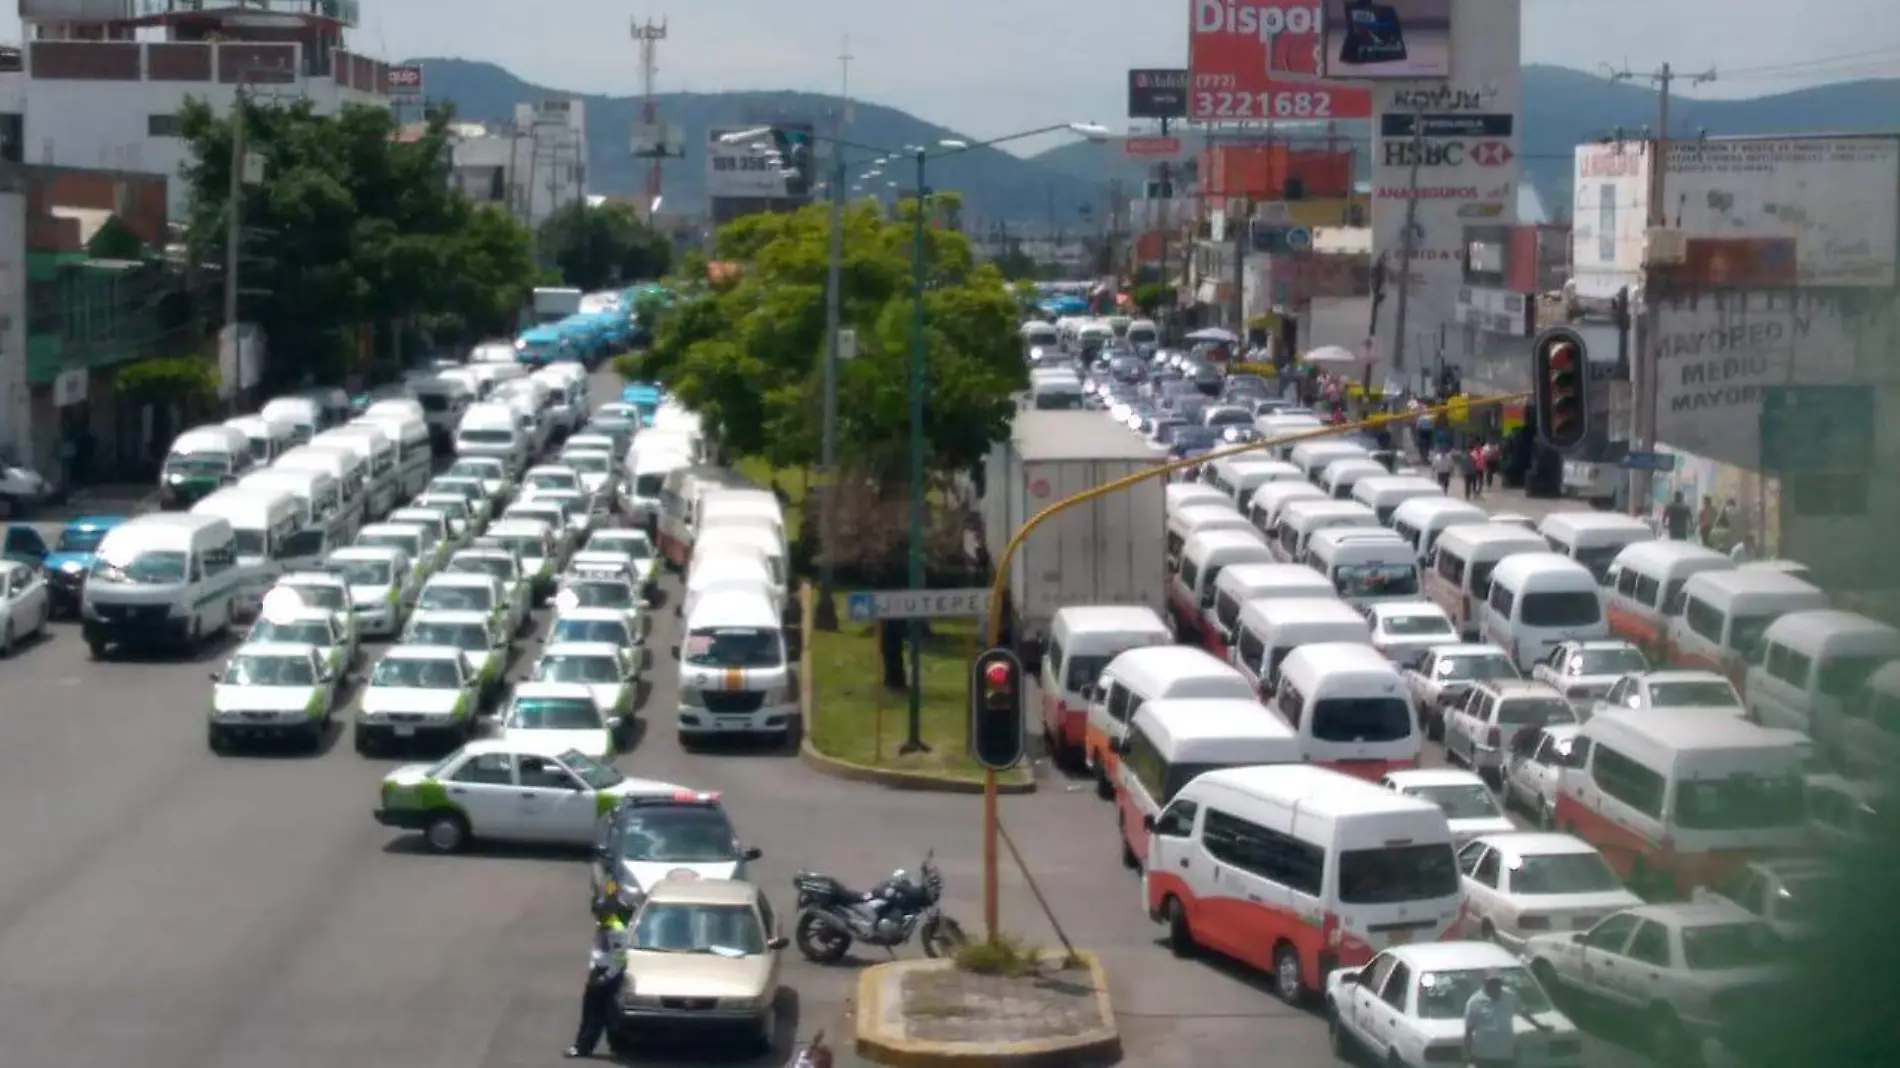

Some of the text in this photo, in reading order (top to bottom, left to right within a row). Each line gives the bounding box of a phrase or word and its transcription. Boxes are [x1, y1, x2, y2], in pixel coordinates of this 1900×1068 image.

[1195, 92, 1331, 116] 3221682
[1383, 142, 1464, 166] HSBC
[1680, 357, 1768, 386] MEDIO
